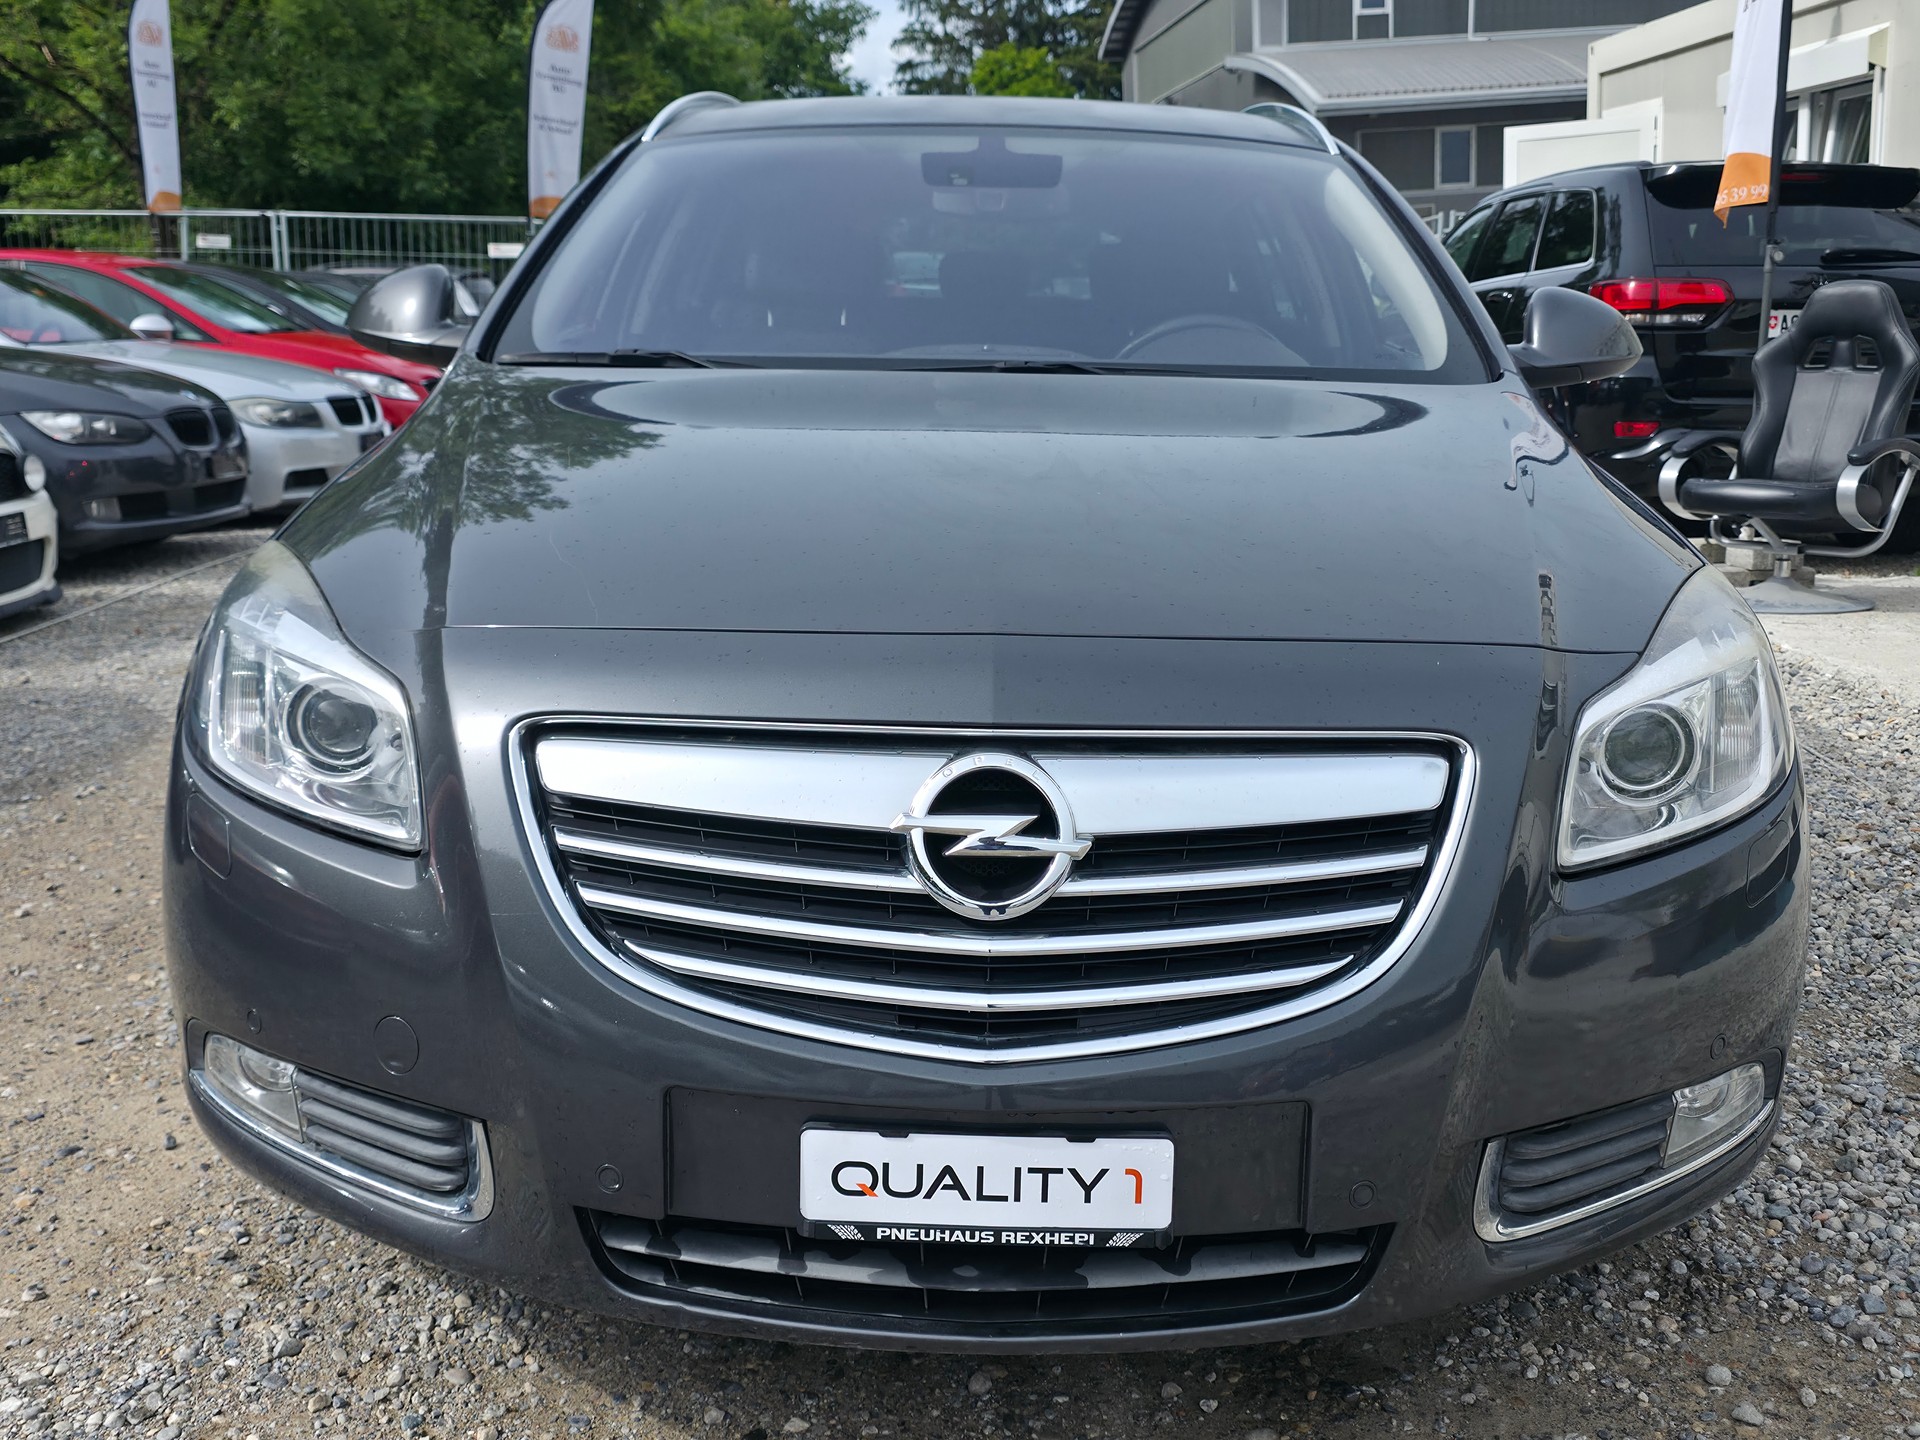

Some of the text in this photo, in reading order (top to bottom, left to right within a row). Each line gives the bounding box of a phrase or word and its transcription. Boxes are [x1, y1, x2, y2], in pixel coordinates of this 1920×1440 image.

[1730, 186, 1748, 203] 39
[1750, 183, 1768, 200] 99
[942, 755, 1041, 782] OPEL
[831, 1160, 1143, 1205] QUALITY 1
[876, 1227, 1095, 1246] PNEUHAUS REXHEPI
